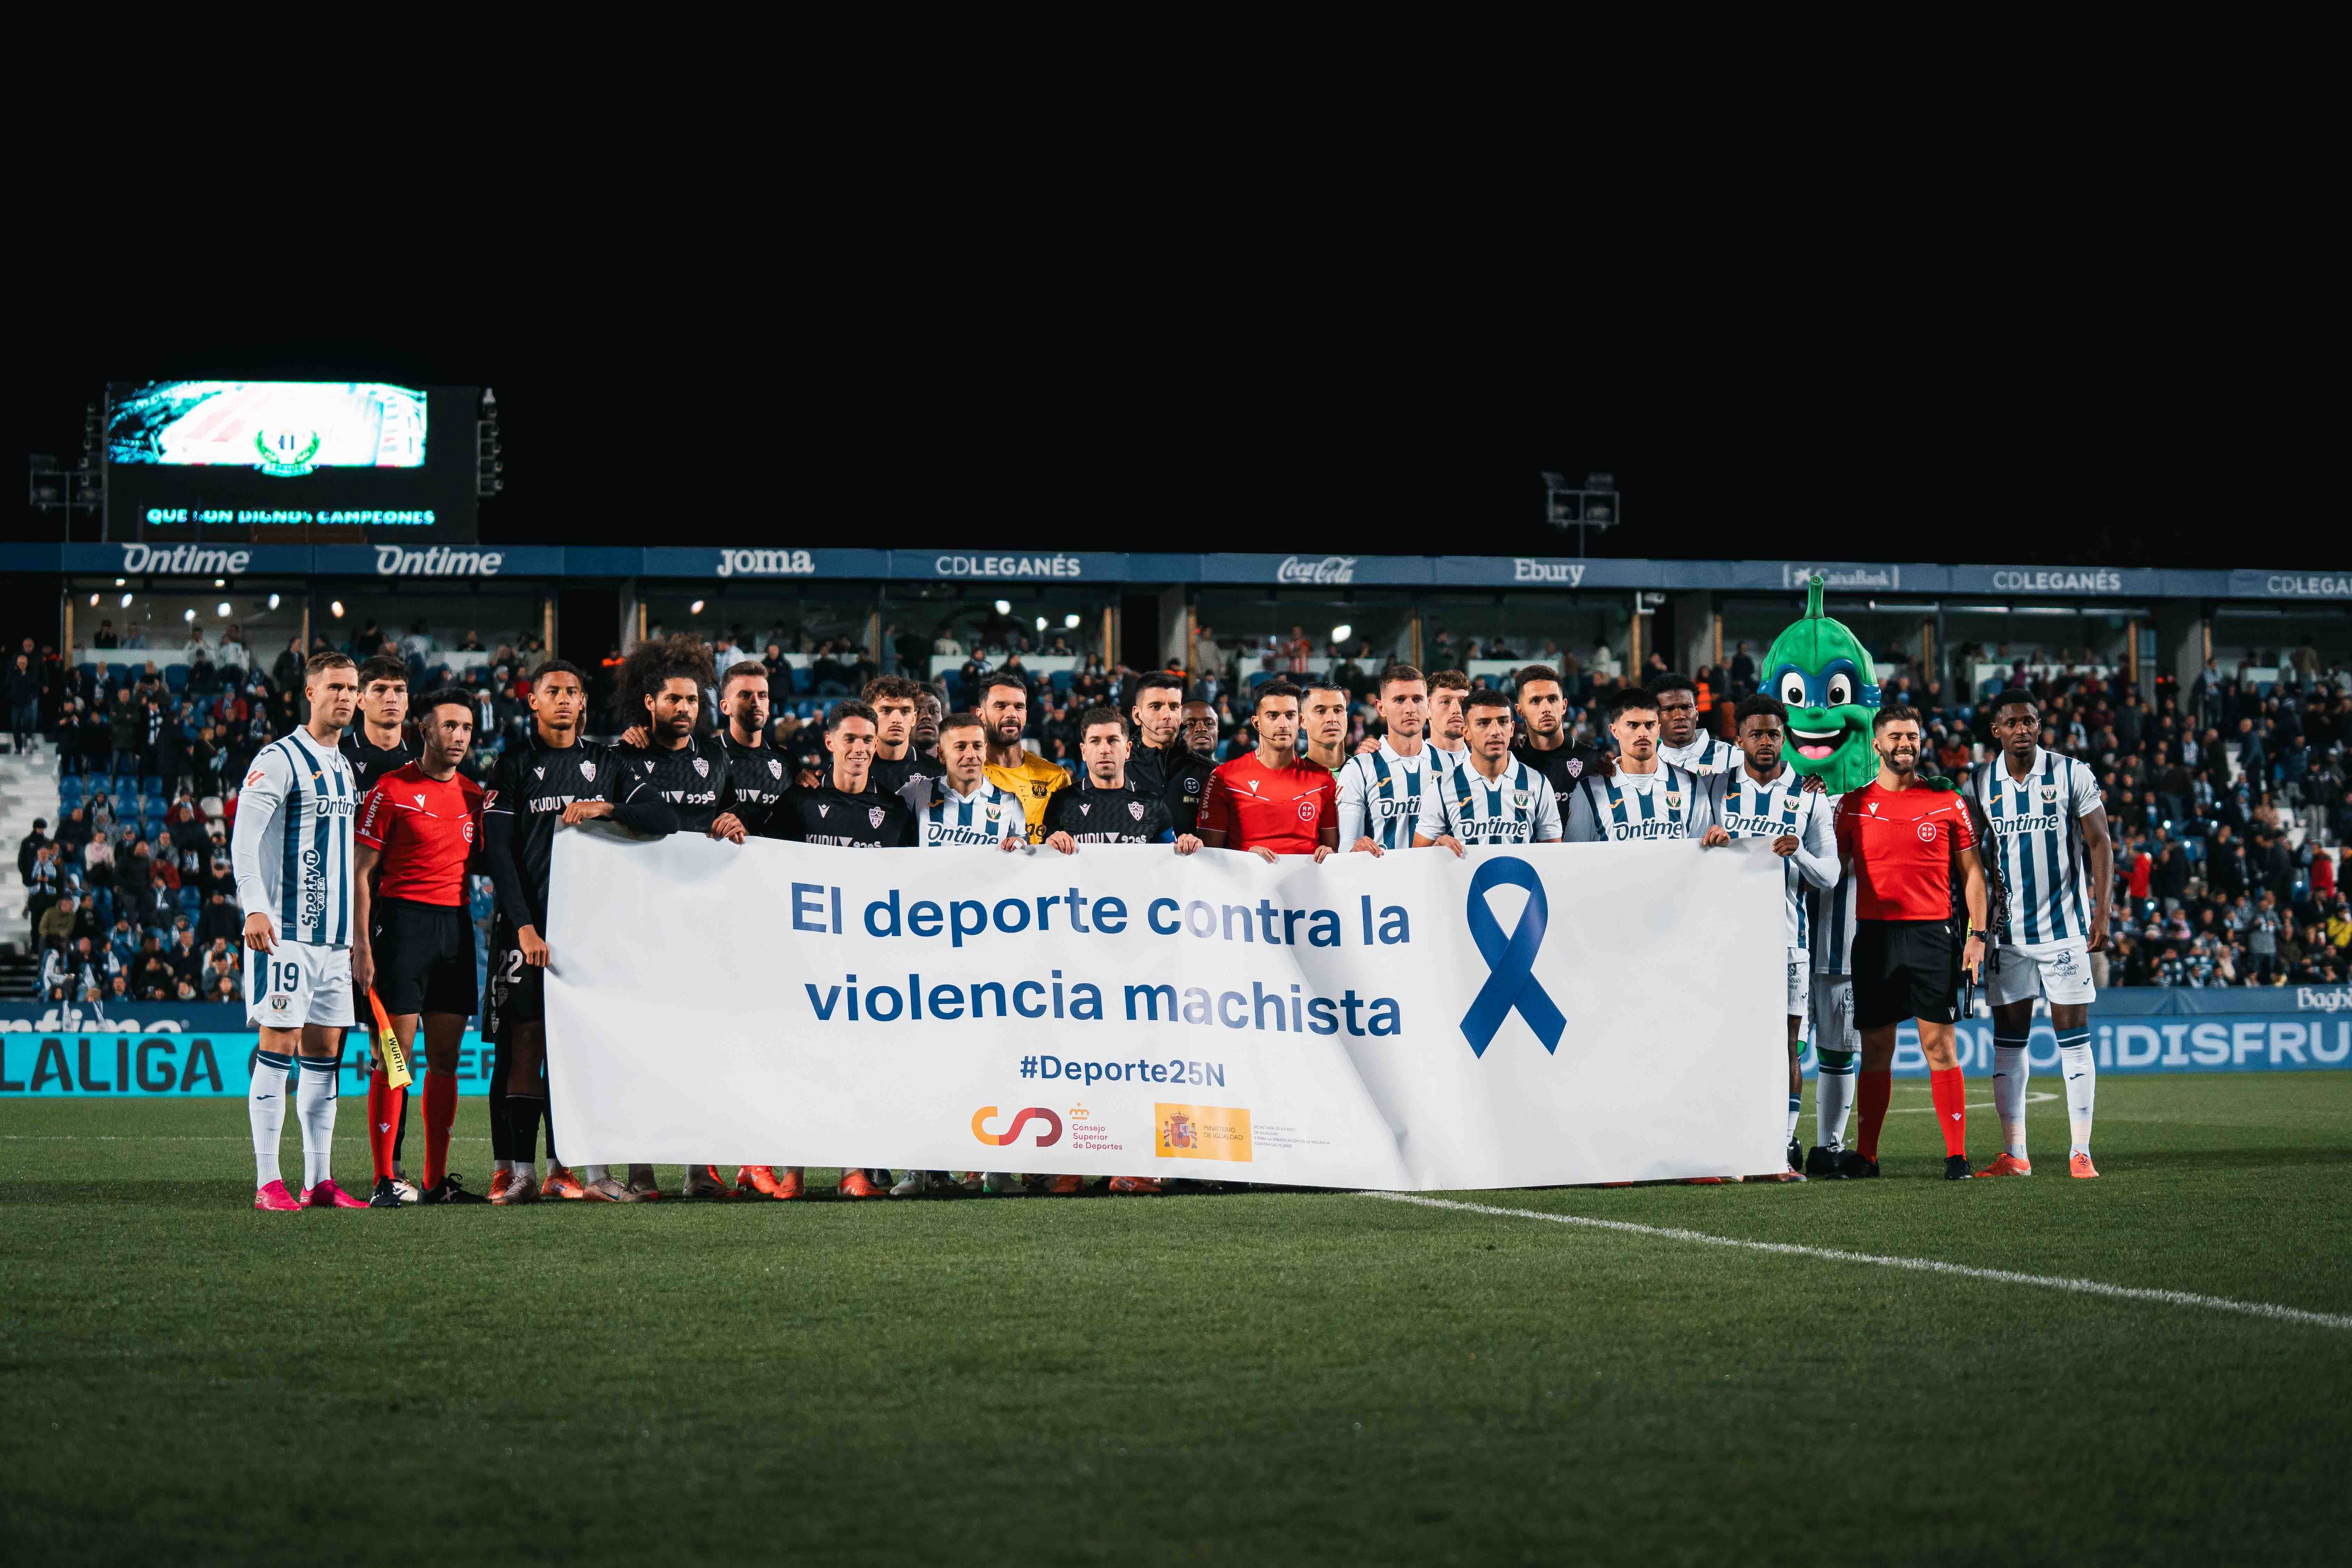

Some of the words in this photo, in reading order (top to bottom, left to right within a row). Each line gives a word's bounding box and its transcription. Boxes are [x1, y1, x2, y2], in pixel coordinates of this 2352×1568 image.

[121, 543, 251, 573] Ontime
[375, 545, 502, 576] Ontime
[1513, 558, 1586, 588] Ebury
[2267, 575, 2352, 595] CDLEGA
[315, 797, 354, 815] Ontim
[530, 796, 561, 813] KUDU
[1378, 797, 1422, 816] Onti
[927, 824, 999, 845] Ontime
[1459, 818, 1527, 837] Ontime
[1613, 819, 1682, 841] Ontime
[1724, 813, 1797, 835] Ontime
[1991, 814, 2058, 834] Ontime
[306, 852, 316, 864] TV
[302, 867, 321, 928] Sporty
[791, 882, 842, 934] El
[864, 887, 1128, 947] deporte
[1148, 897, 1341, 947] contra
[1361, 895, 1410, 945] la
[271, 961, 300, 992] 19
[804, 969, 1103, 1022] violencia
[1124, 981, 1402, 1036] machista
[0, 1037, 224, 1093] LALIGA
[389, 1037, 405, 1072] WÜRTH
[1020, 1055, 1225, 1087] #Deporte25N
[1072, 1123, 1105, 1133] Consejo
[1073, 1133, 1108, 1141] Superior
[1086, 1142, 1123, 1151] Deportes
